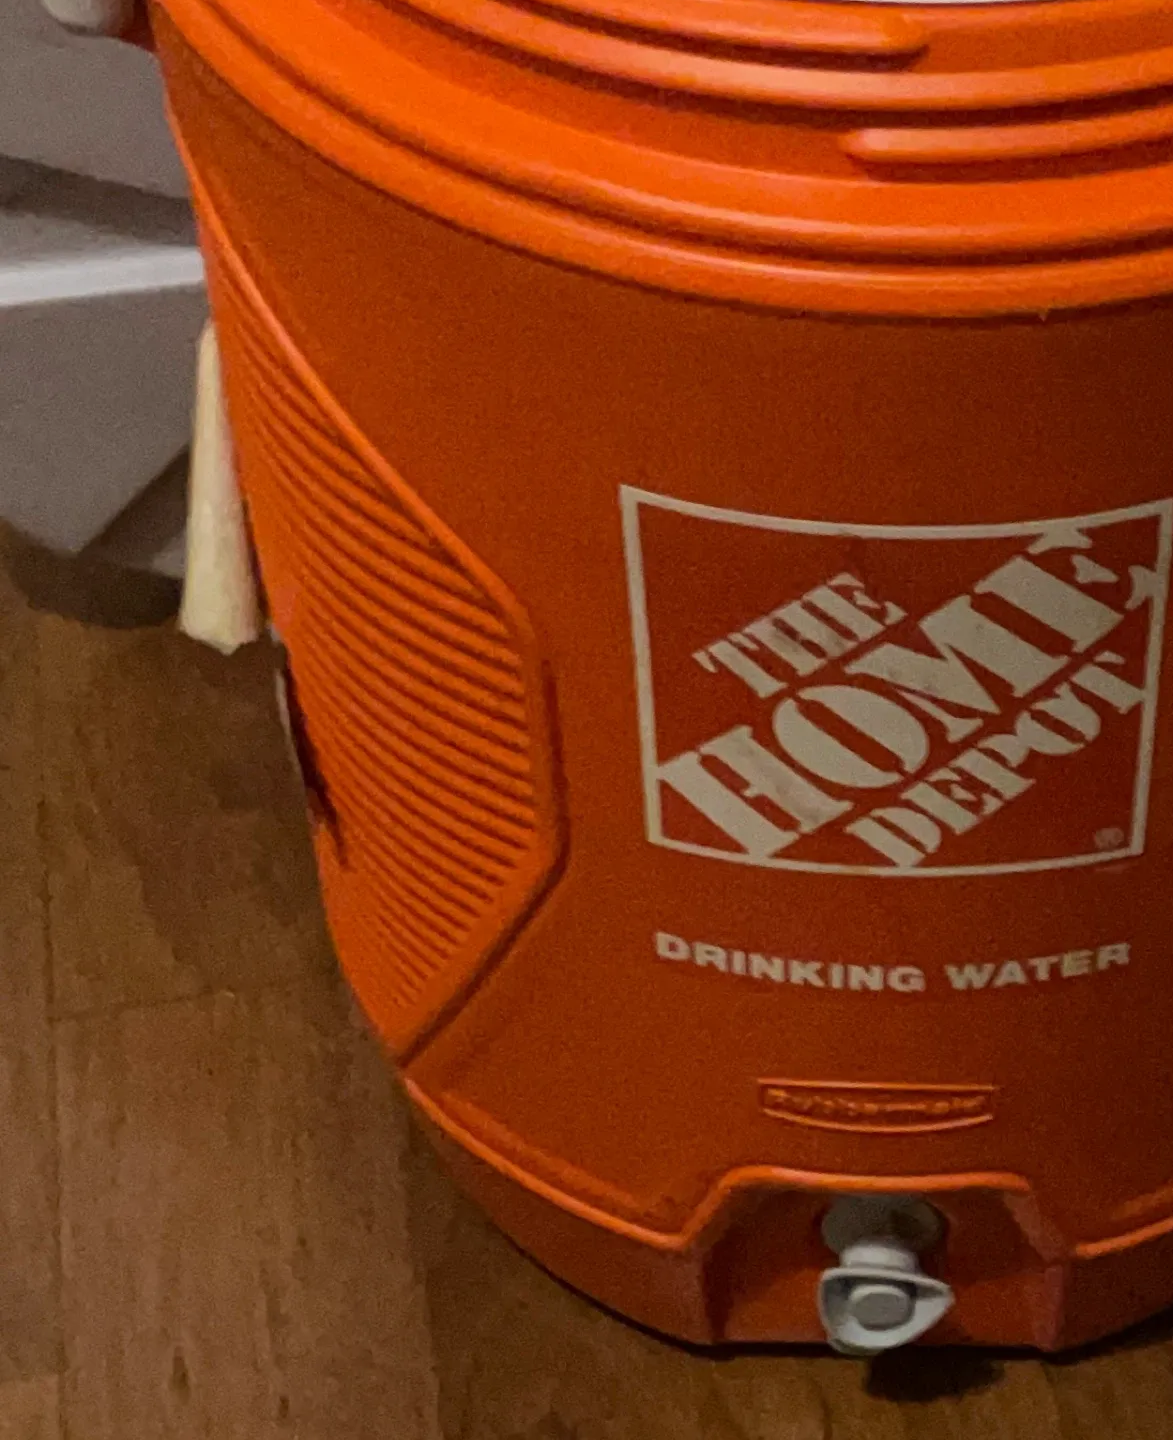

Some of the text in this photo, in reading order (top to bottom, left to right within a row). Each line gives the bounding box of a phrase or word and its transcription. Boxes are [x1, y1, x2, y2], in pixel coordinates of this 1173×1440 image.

[656, 527, 1157, 859] HOME
[692, 571, 908, 698] THE
[843, 650, 1145, 866] DEPOT
[655, 931, 1131, 992] DRINKING WATER
